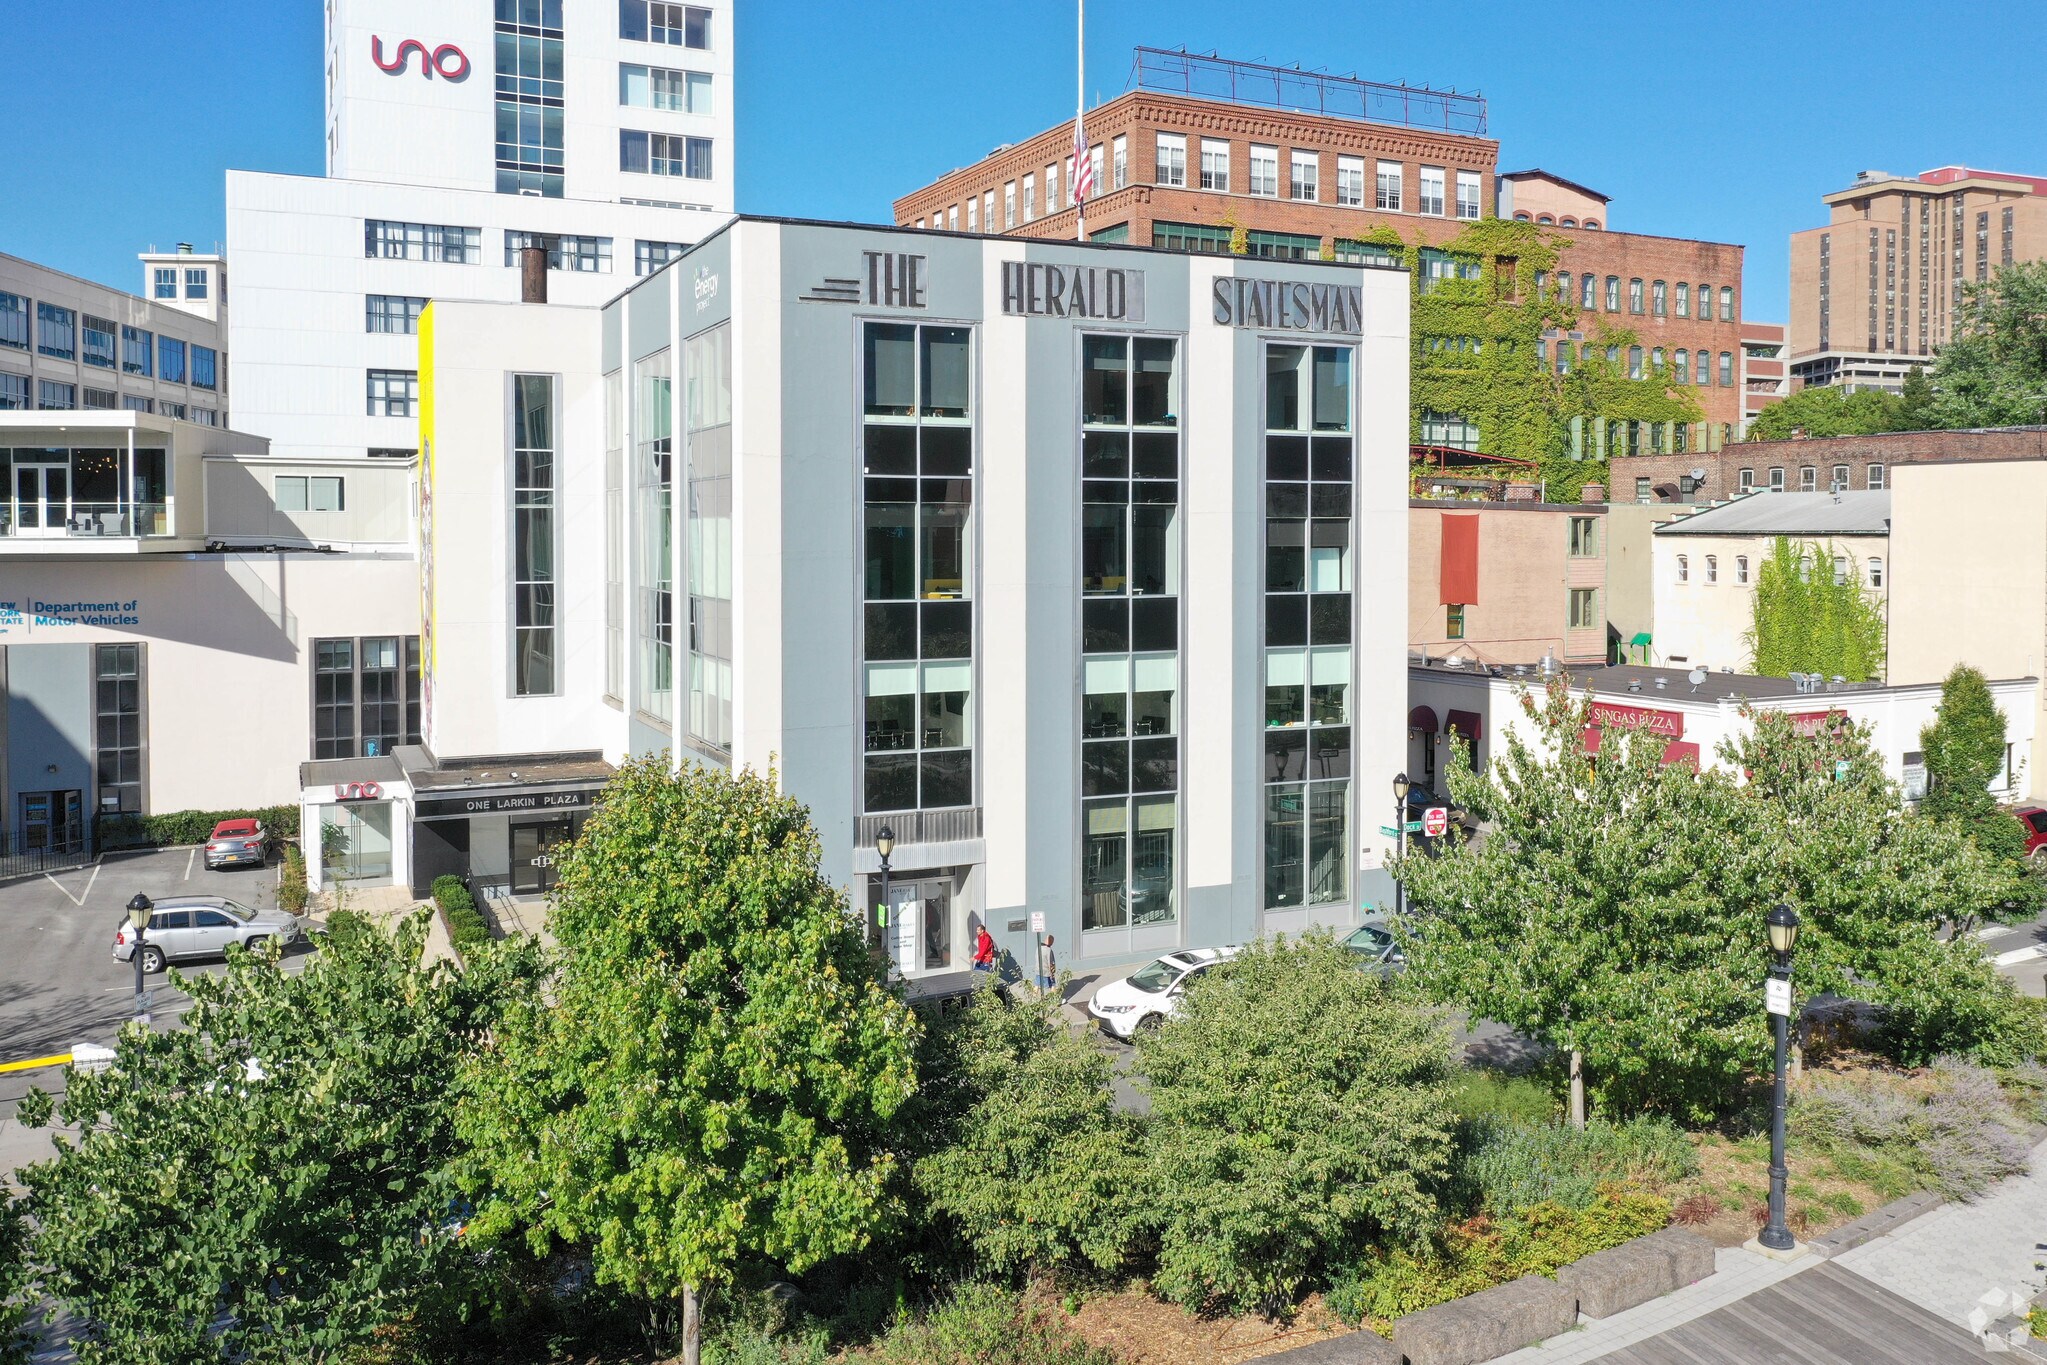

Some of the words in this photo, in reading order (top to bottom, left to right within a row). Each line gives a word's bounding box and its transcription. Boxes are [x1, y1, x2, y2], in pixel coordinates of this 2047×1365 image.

[695, 274, 718, 299] energy
[863, 251, 926, 308] THE
[1003, 261, 1126, 319] HERALD
[1213, 277, 1362, 332] STATESMAN
[0, 609, 21, 617] ORK
[34, 601, 120, 615] Department
[123, 600, 137, 611] of
[0, 617, 24, 625] TATE
[35, 615, 78, 626] Motor
[81, 613, 139, 625] Vehicles
[1594, 708, 1636, 725] SINGAS
[1639, 713, 1674, 730] PIZZA
[466, 801, 490, 811] ONE
[497, 797, 535, 809] LARKIN
[544, 794, 579, 805] PLAZA
